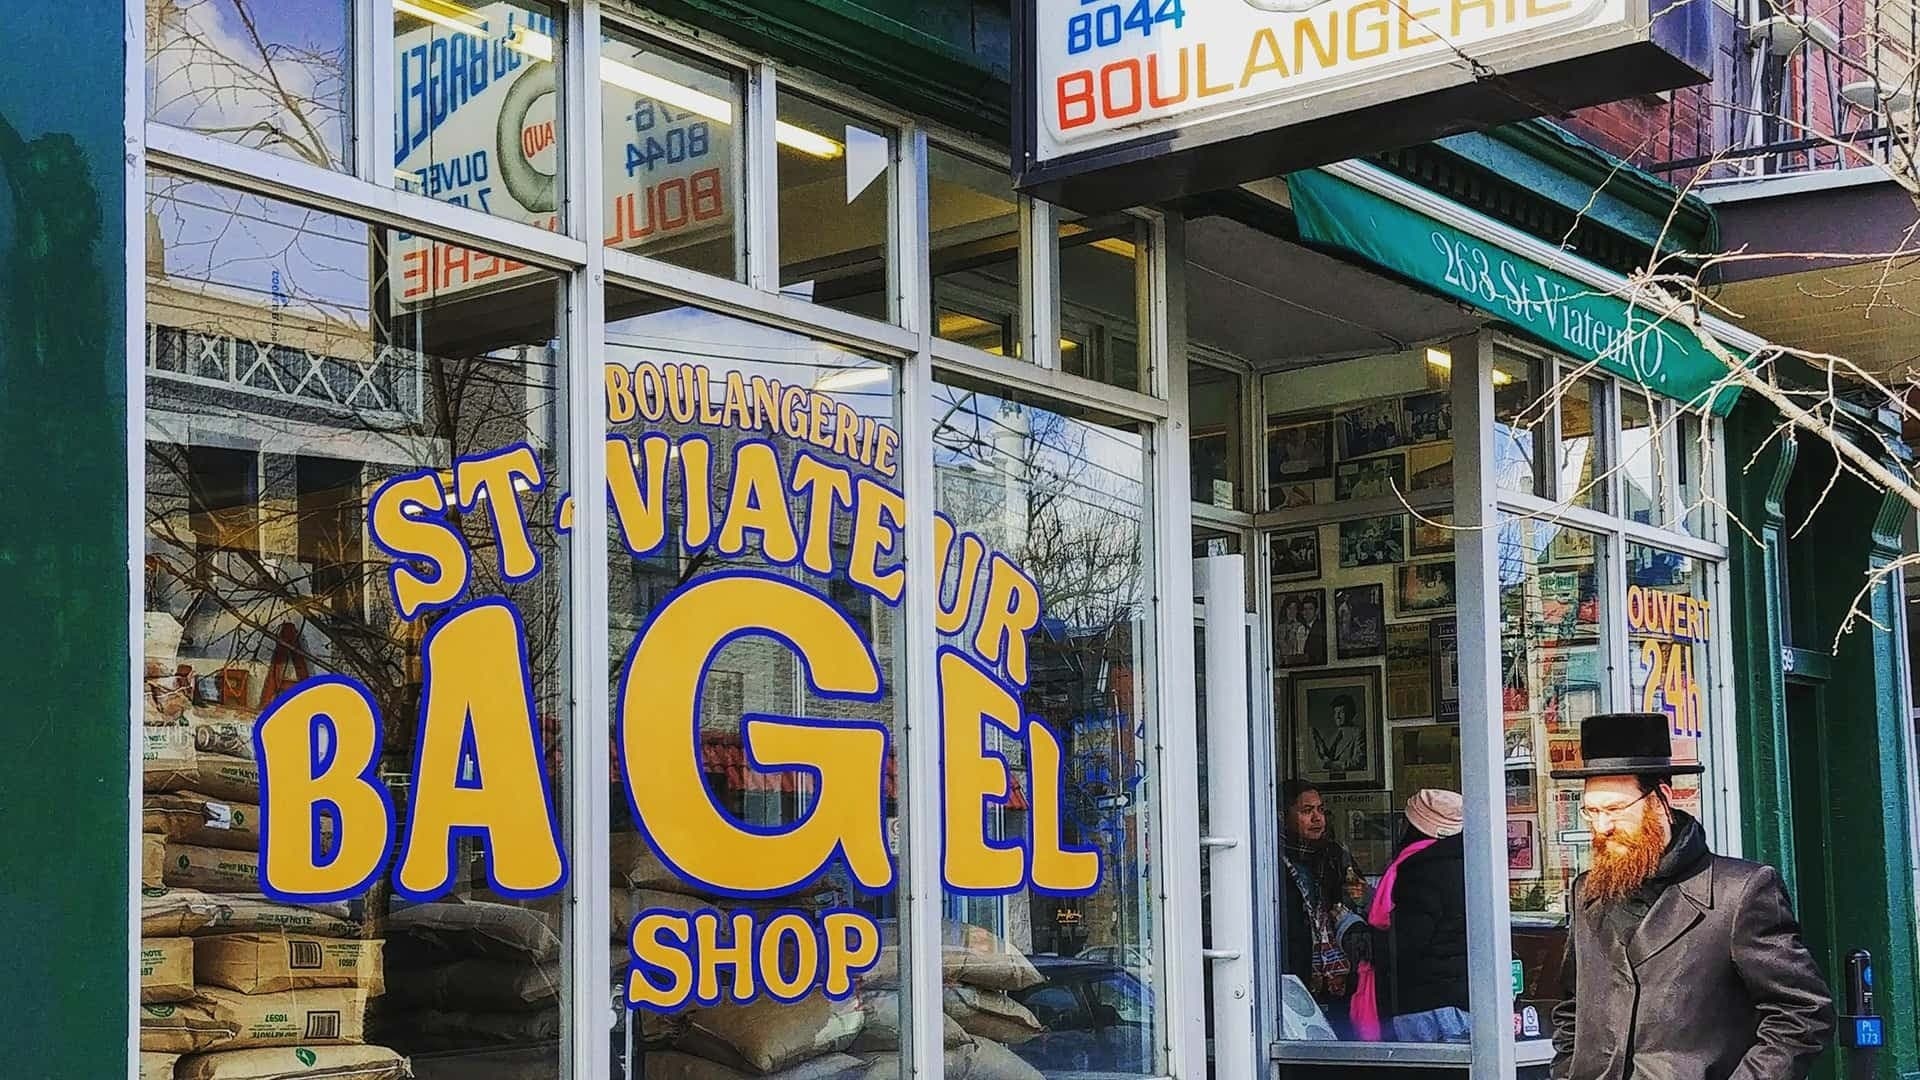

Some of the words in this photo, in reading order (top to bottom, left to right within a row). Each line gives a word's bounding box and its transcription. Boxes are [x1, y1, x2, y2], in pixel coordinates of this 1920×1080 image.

[1068, 0, 1185, 55] 8044
[1431, 231, 1497, 302] 263
[1500, 260, 1632, 367] St-Viateur
[605, 361, 900, 477] BOULANGERIE
[1627, 585, 1711, 643] OUVERT
[1639, 638, 1702, 738] 24h
[254, 569, 1102, 902] BAGEL
[626, 907, 882, 1014] SHOP
[265, 1013, 288, 1023] 10597
[1861, 1032, 1879, 1045] 173
[1862, 1020, 1874, 1033] PL
